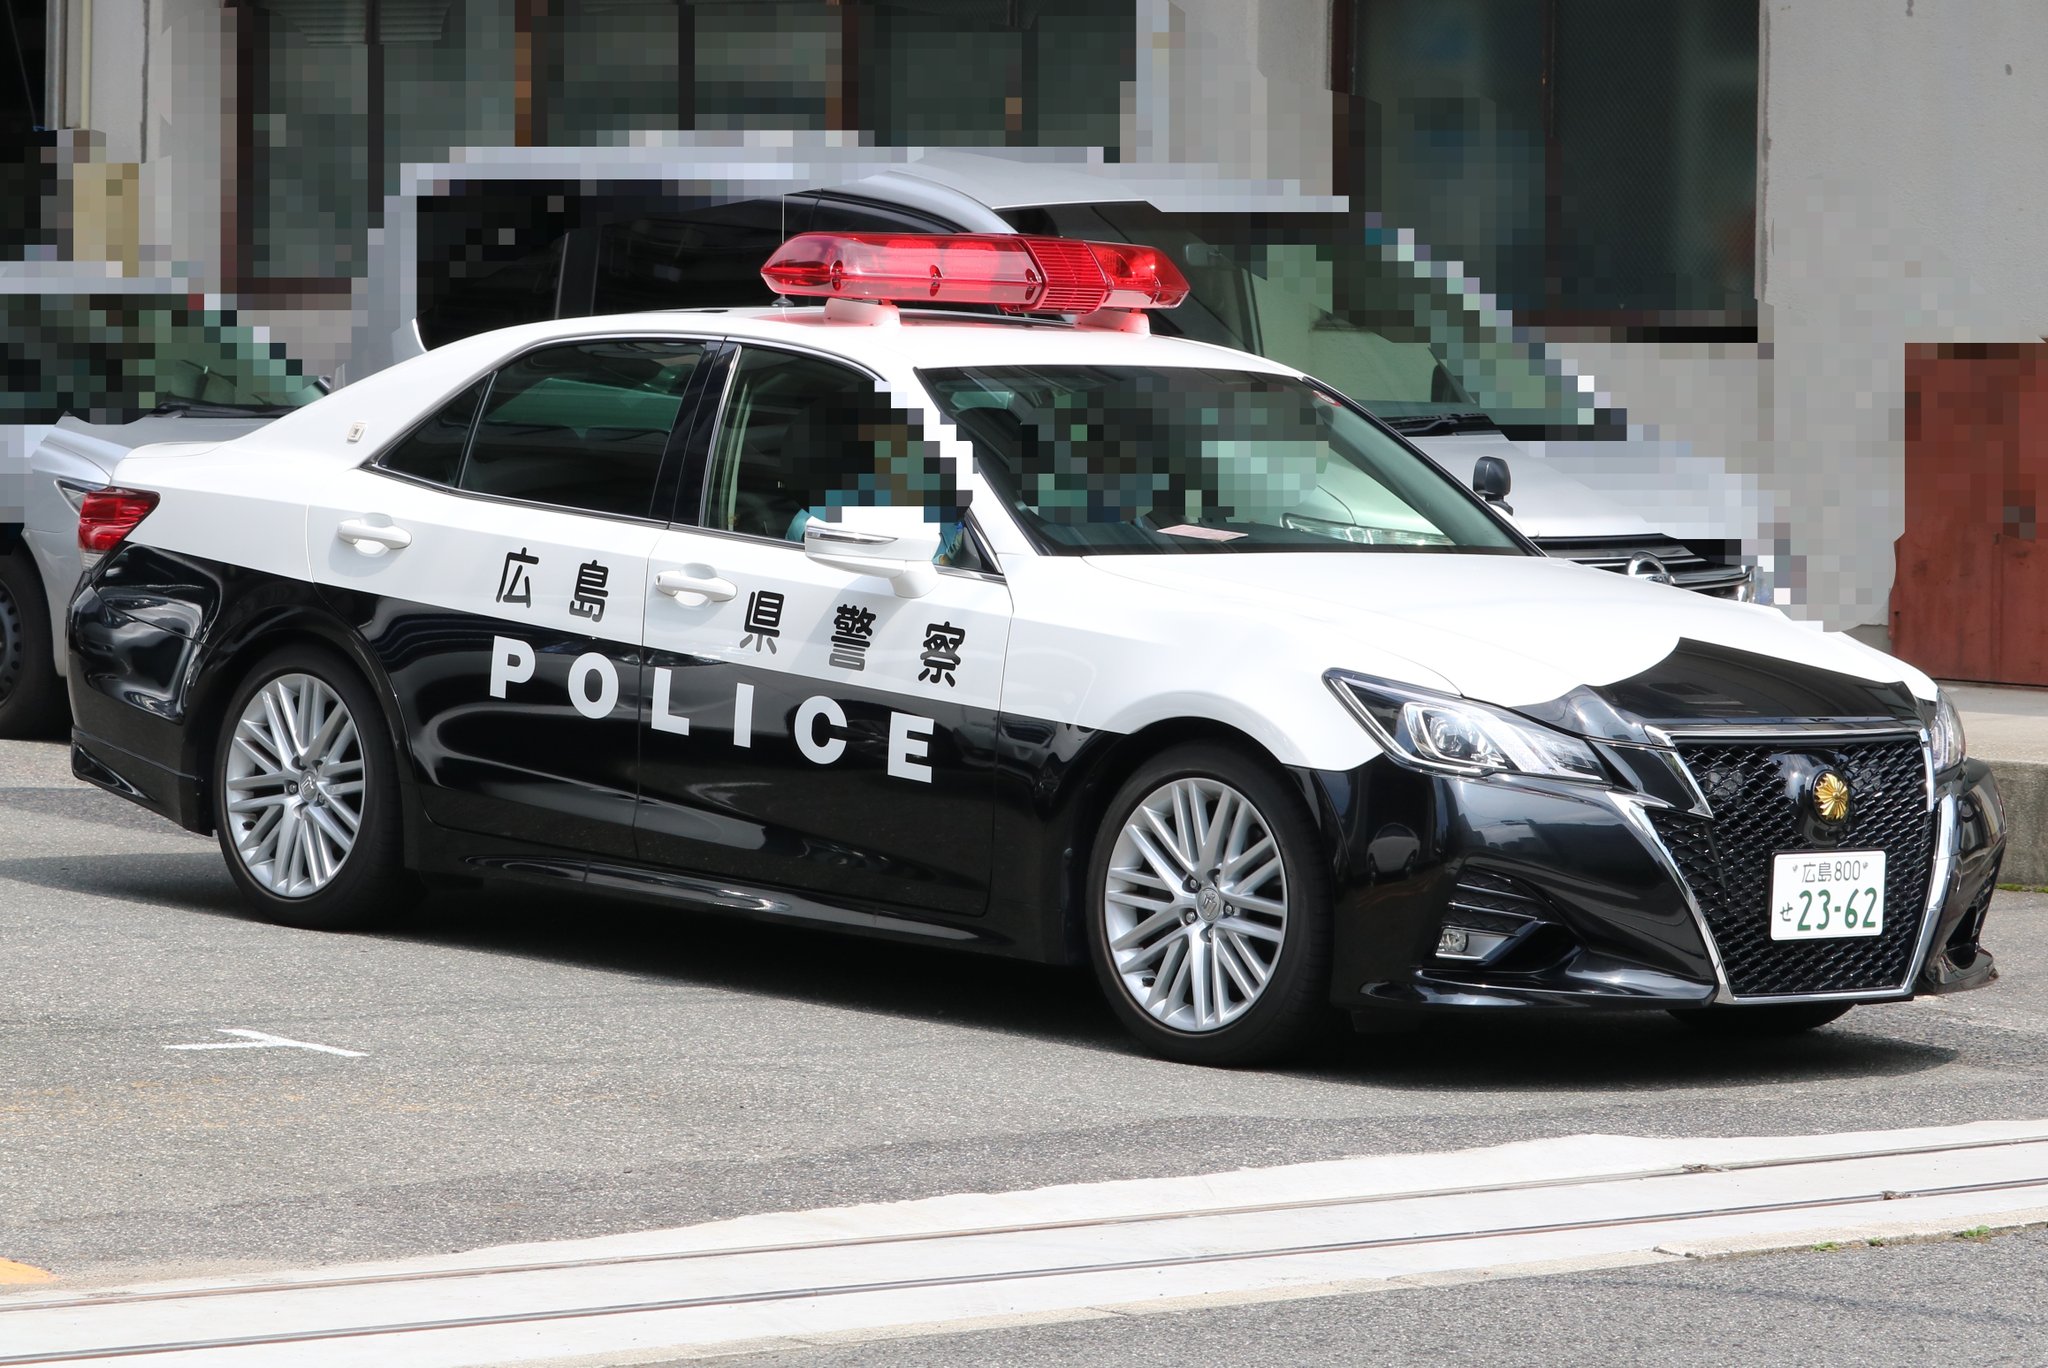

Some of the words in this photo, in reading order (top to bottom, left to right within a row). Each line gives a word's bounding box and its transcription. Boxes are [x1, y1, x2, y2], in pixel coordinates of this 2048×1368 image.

[496, 546, 966, 688] 広島県警察
[489, 635, 936, 784] POLICE
[1797, 887, 1877, 931] 23-62
